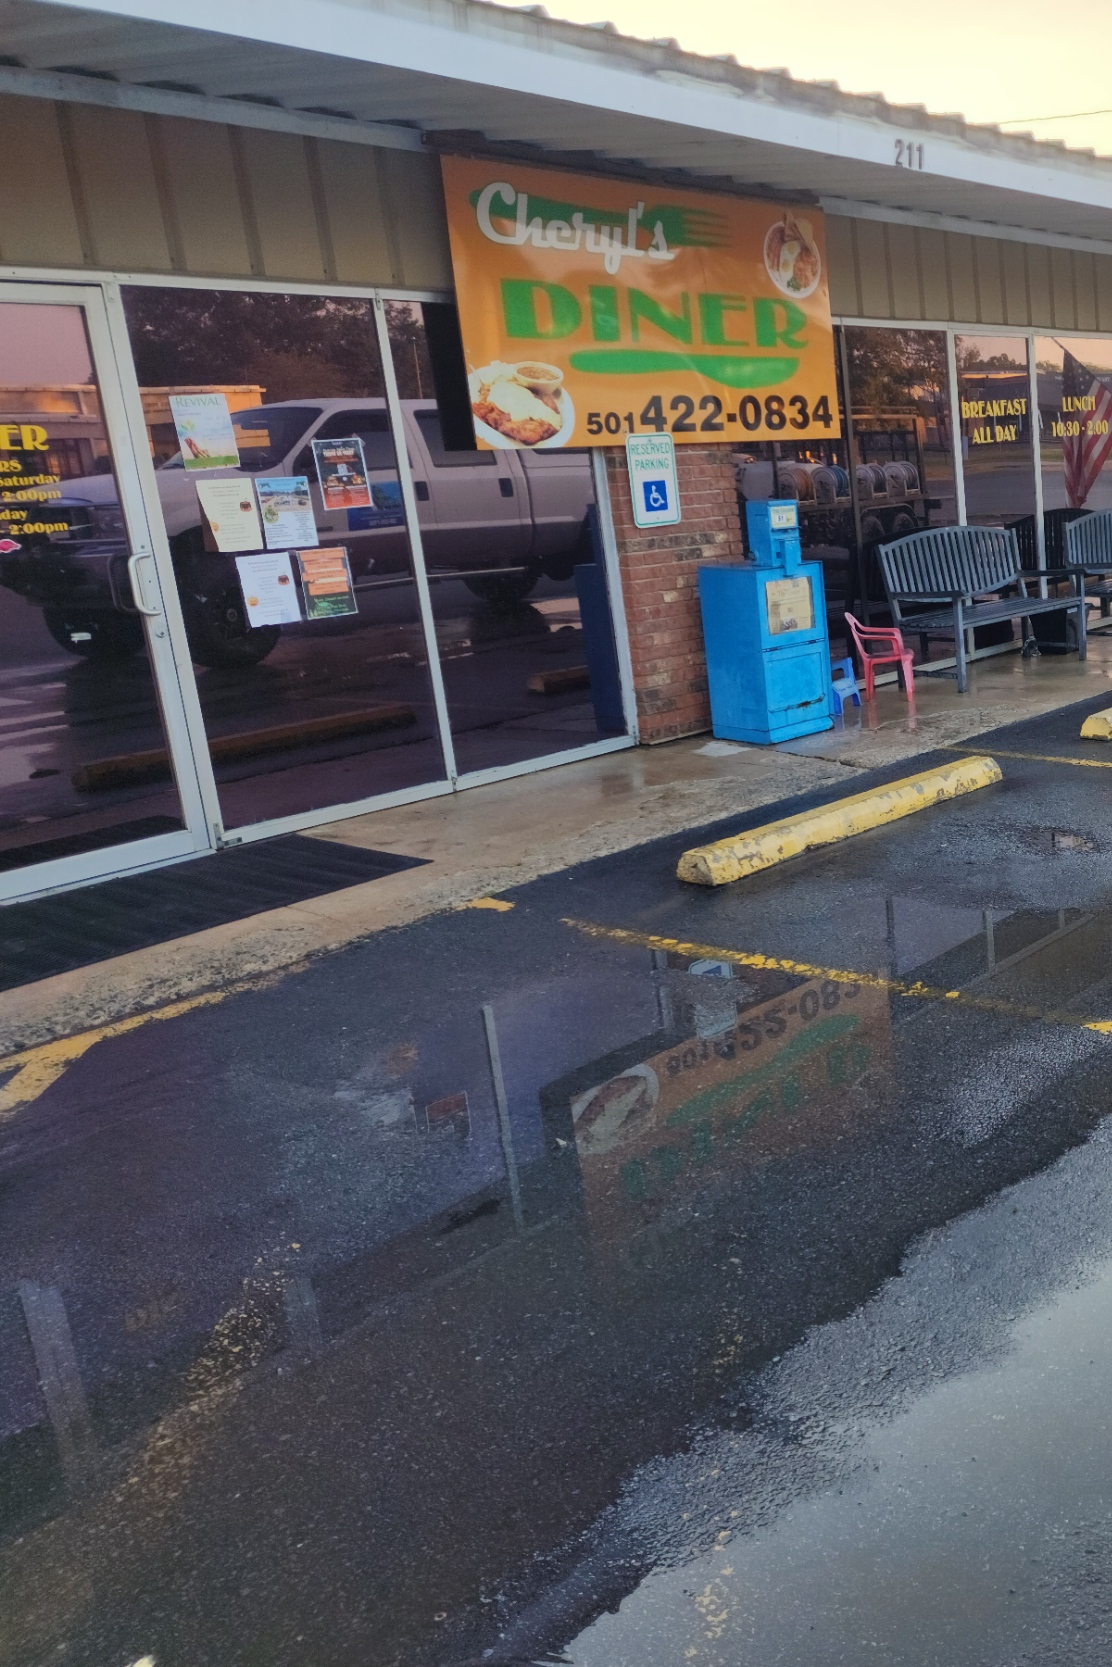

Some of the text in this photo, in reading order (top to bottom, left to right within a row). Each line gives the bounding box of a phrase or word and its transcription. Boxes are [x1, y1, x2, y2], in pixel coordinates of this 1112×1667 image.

[894, 138, 924, 170] 211
[475, 181, 675, 275] Cheryl's
[500, 278, 809, 349] DINER
[961, 398, 1027, 419] BREAKFAST
[1062, 395, 1096, 412] LUNCH
[586, 394, 834, 435] 501 422-0834
[972, 424, 1017, 444] ALL DAY
[1051, 421, 1080, 437] 10:30
[1086, 419, 1109, 436] 2:00
[0, 424, 49, 451] ER
[630, 442, 671, 456] RESERVED
[0, 459, 22, 472] RS
[635, 458, 670, 470] PARKING
[2, 489, 61, 502] 2:00pm
[0, 509, 28, 521] day
[9, 522, 68, 535] 2:00pm
